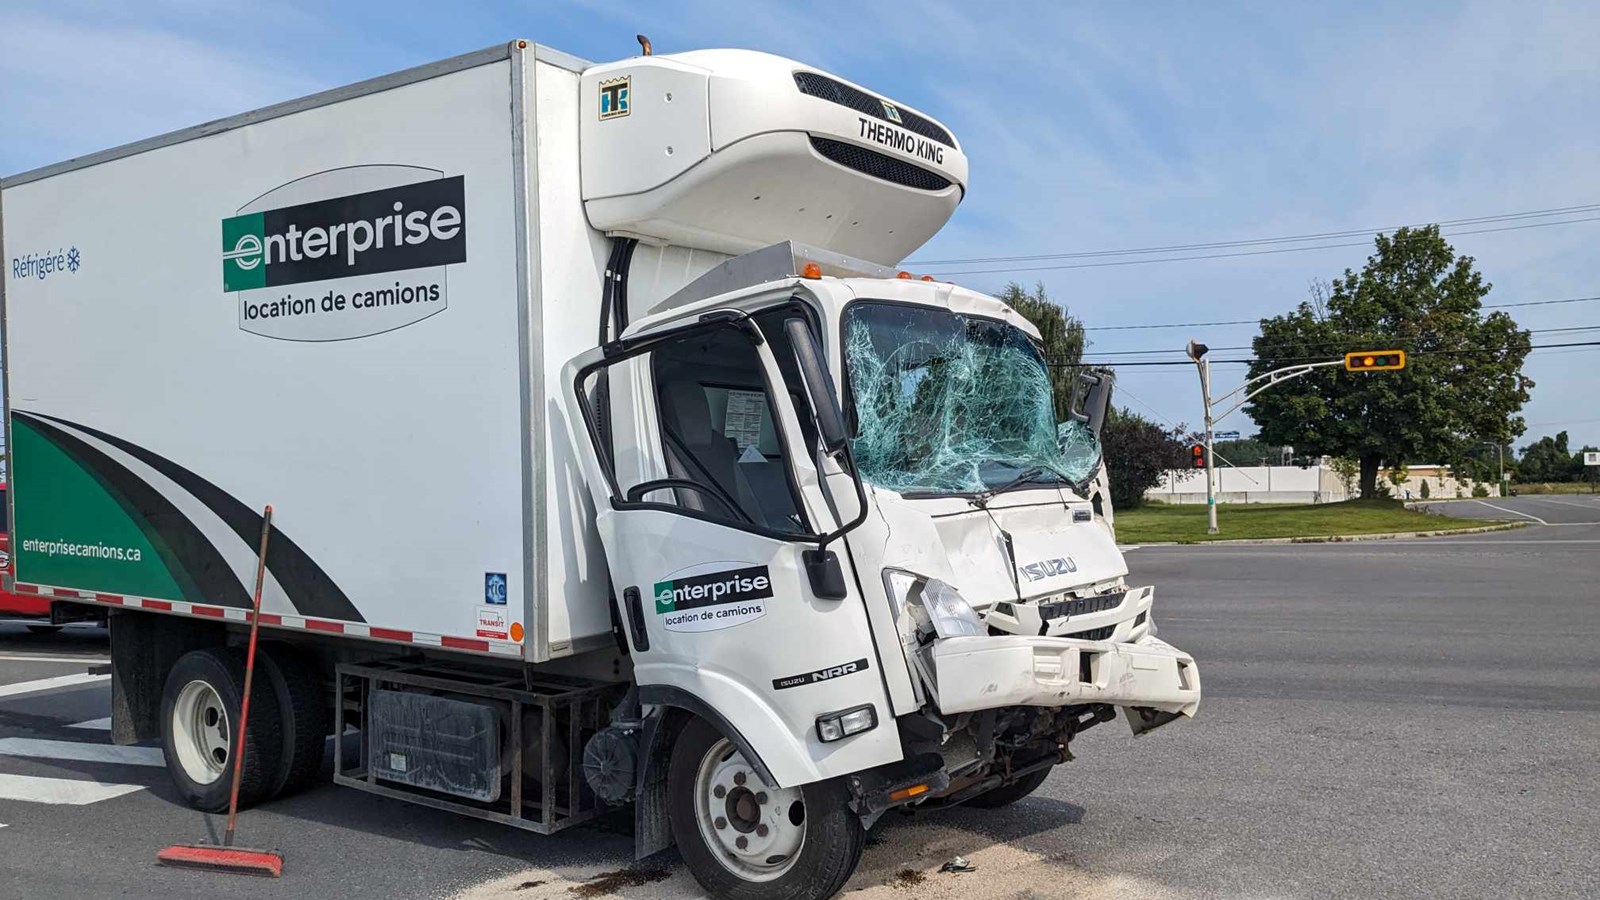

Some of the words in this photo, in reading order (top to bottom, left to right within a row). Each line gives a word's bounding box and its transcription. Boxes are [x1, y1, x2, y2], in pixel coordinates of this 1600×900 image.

[858, 117, 915, 153] THERMO
[916, 138, 944, 165] KING
[223, 201, 462, 271] enterprise
[12, 247, 65, 280] Réfrigéré
[243, 294, 316, 320] location
[320, 290, 346, 312] de
[352, 281, 440, 308] camions
[23, 538, 141, 561] enterprisecamions.ca
[1019, 557, 1077, 582] ISUZU
[655, 574, 769, 605] enterprise
[479, 619, 504, 628] TRANSIT
[665, 612, 699, 626] location
[700, 610, 714, 621] de
[716, 604, 762, 619] camions
[780, 676, 805, 687] ISUZU
[811, 662, 858, 682] NRR
